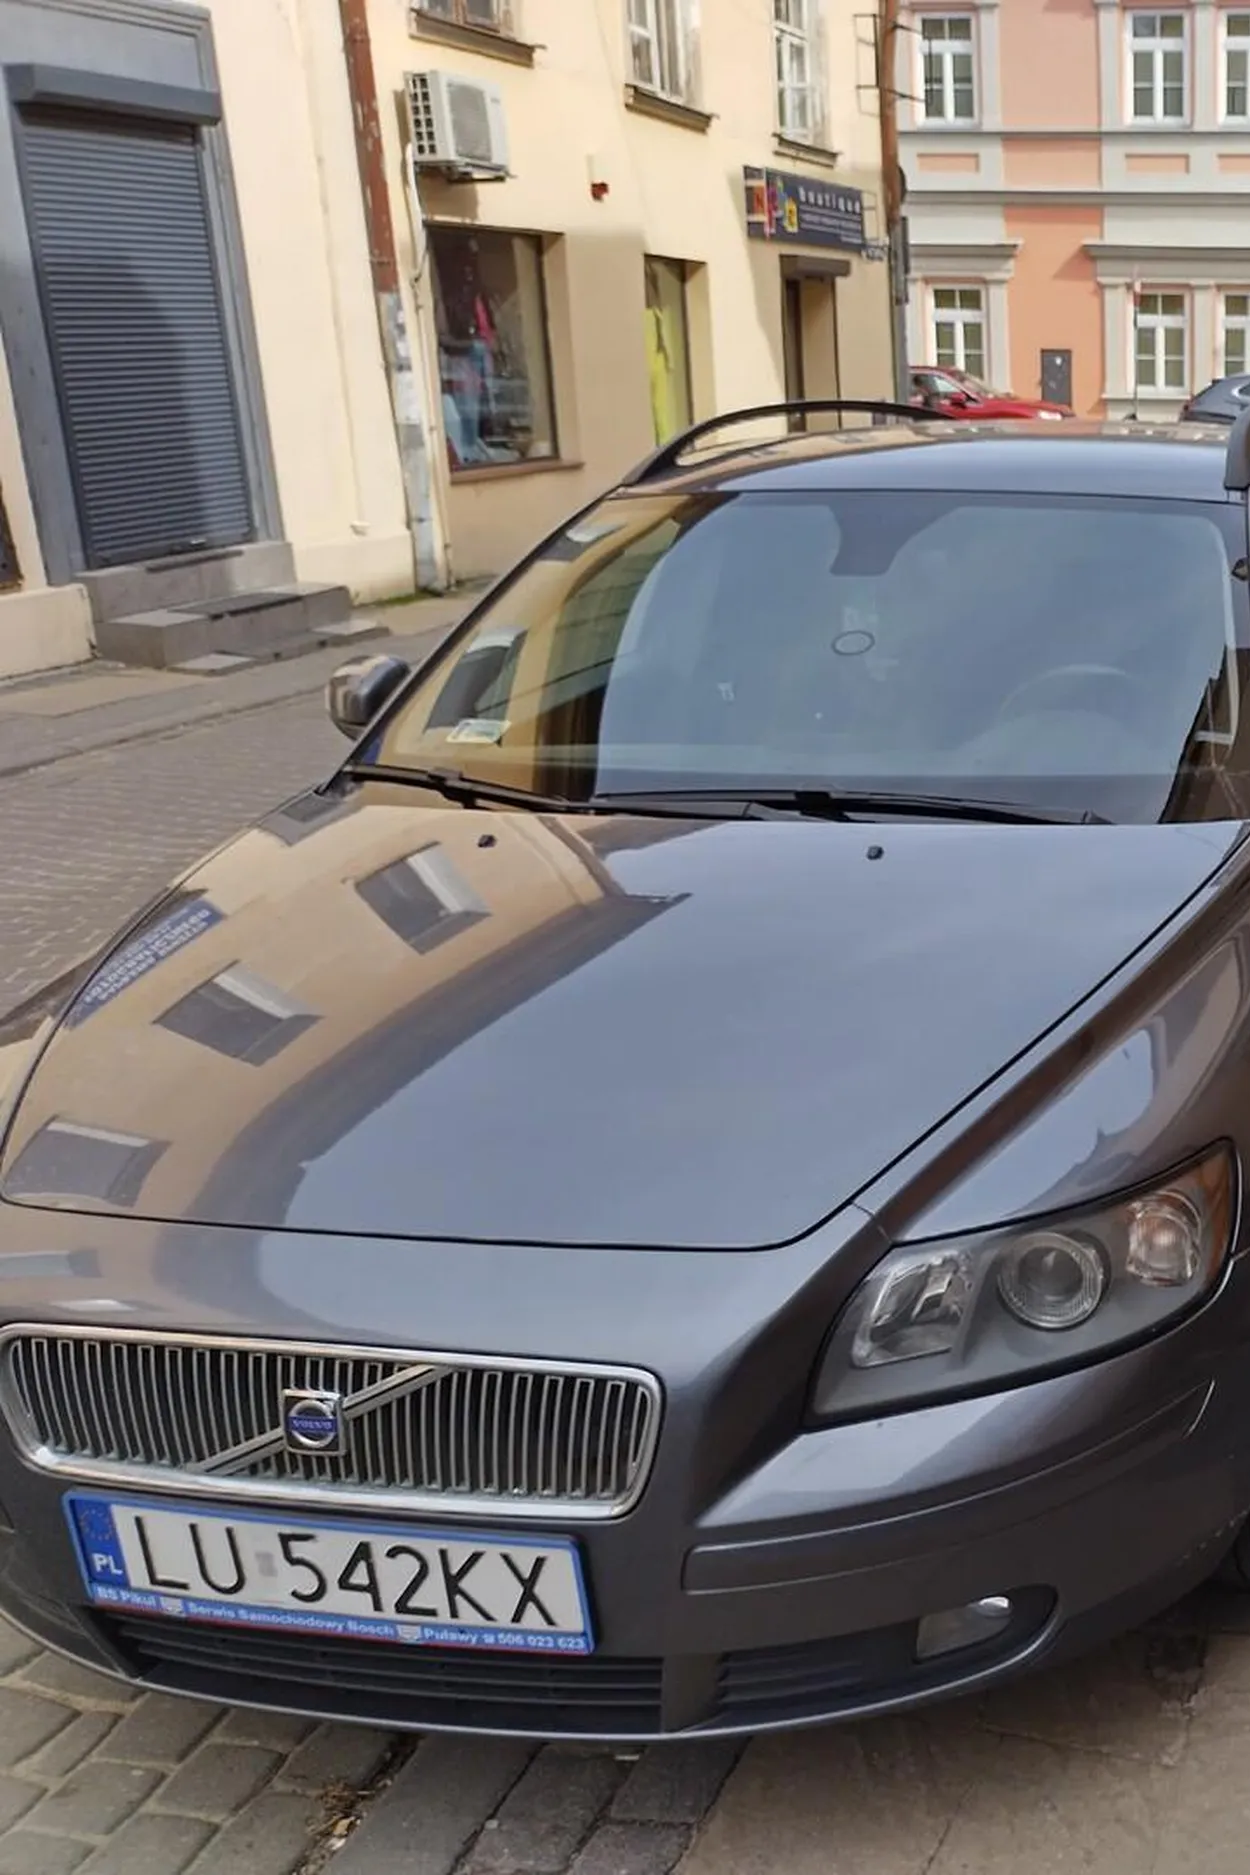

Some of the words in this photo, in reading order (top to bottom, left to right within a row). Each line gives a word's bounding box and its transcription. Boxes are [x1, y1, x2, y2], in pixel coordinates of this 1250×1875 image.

[292, 1419, 333, 1430] VOLVO
[94, 1552, 123, 1576] PL
[134, 1515, 246, 1595] LU
[278, 1532, 556, 1627] 542KX
[188, 1602, 236, 1619] Serwis
[238, 1608, 344, 1634] Samochodowy
